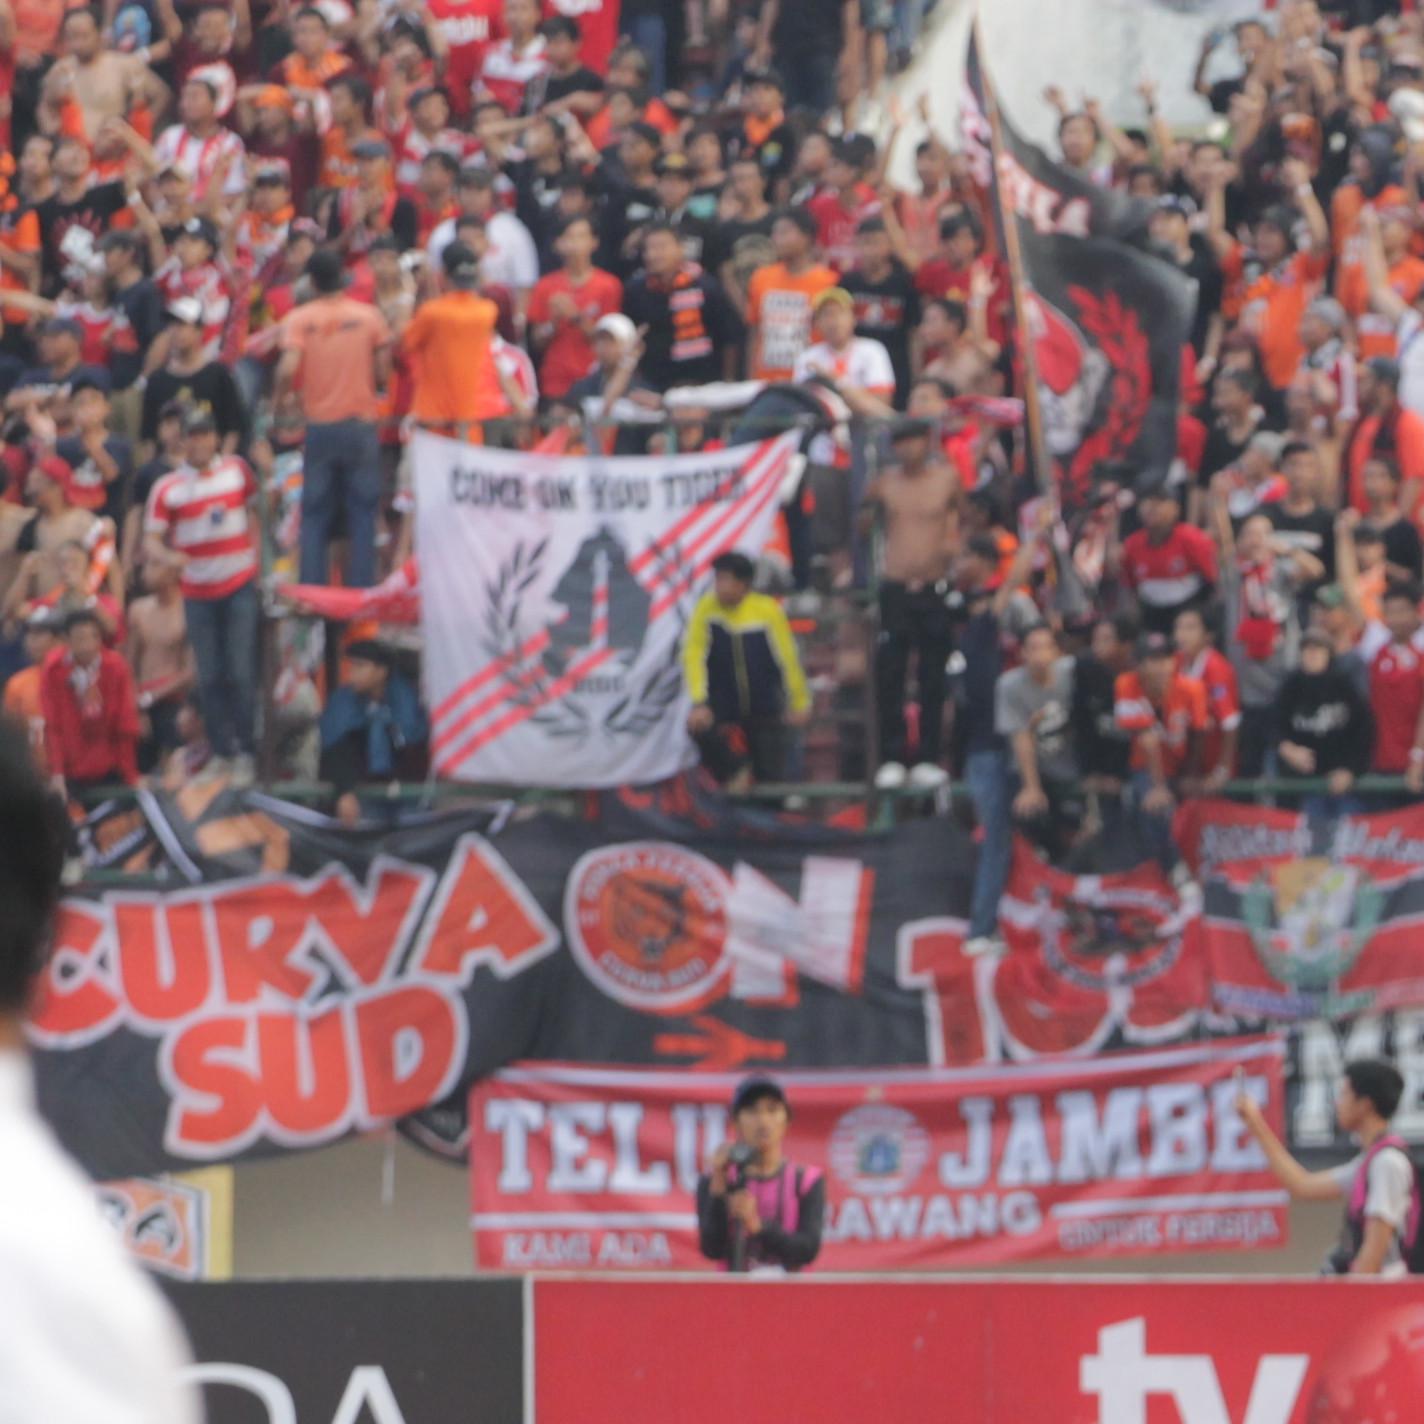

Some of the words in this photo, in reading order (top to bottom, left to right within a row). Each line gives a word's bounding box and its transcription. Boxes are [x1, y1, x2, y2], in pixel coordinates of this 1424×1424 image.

[25, 833, 560, 1049] CURVA
[160, 986, 468, 1159] SUD
[484, 1098, 730, 1195] TELU
[938, 1074, 1268, 1189] JAMBE
[598, 1231, 671, 1264] ADA
